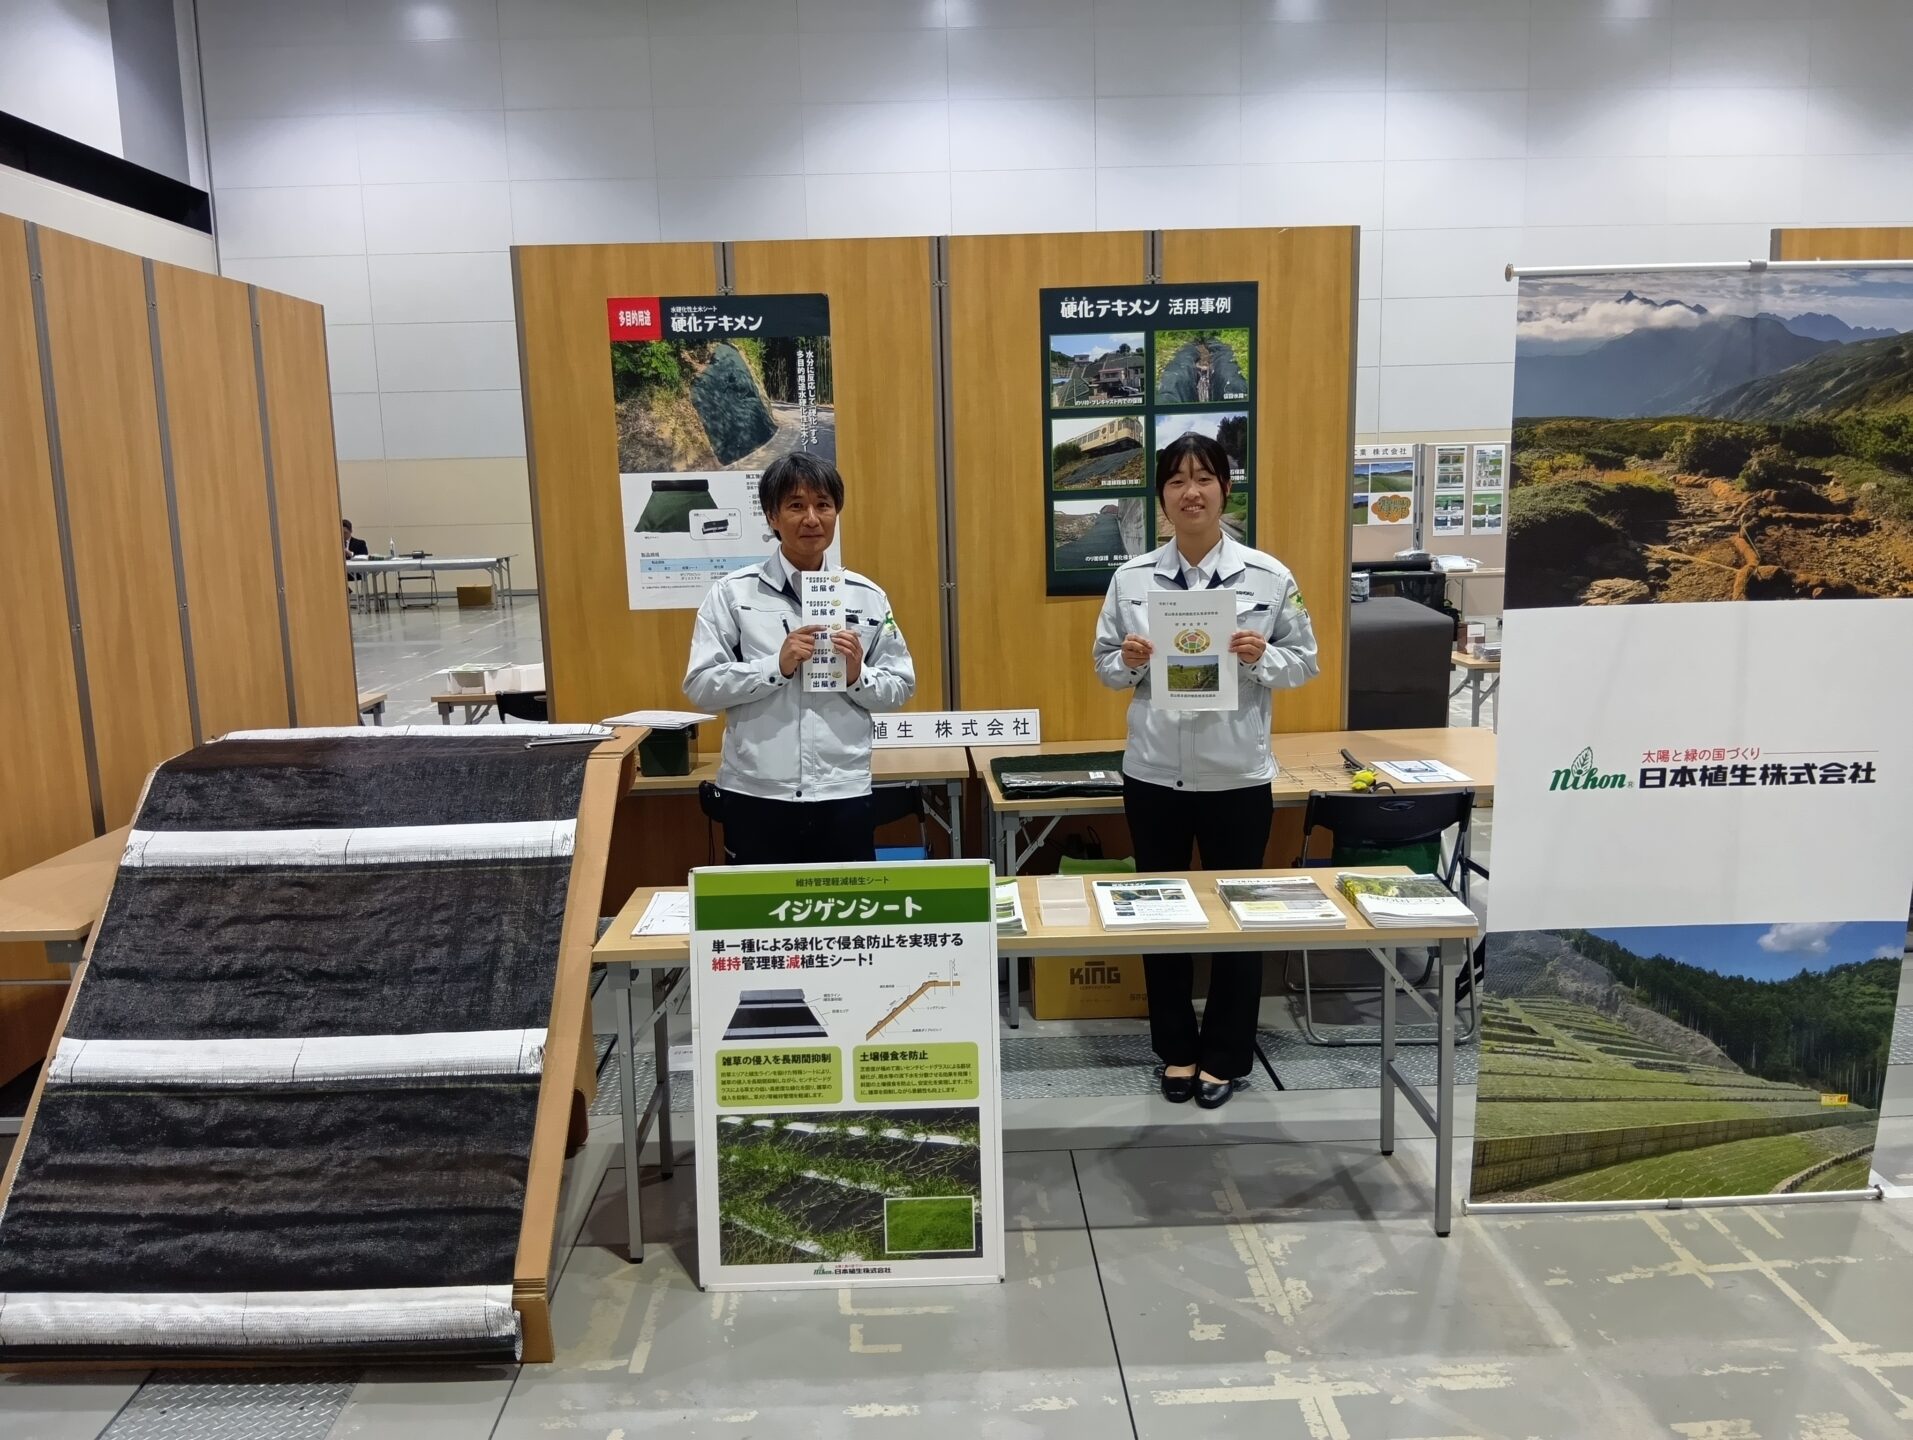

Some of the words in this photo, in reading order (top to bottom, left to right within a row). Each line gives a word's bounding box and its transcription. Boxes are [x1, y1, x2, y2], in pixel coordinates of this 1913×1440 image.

[1060, 299, 1160, 319] 硬化テキメン
[1168, 297, 1232, 316] 活用事例
[618, 310, 652, 327] 多目的用途
[671, 315, 763, 332] 硬化テキメン
[1373, 447, 1407, 456] 株式会社
[873, 720, 914, 740] 植生
[935, 717, 1031, 738] 株式会社
[1641, 747, 1761, 763] 太陽と緑の国づくり
[1638, 761, 1877, 789] 日本植生株式会社
[795, 875, 889, 888] 維持管理軽減植生シート
[768, 896, 922, 922] イジゲンシート
[711, 932, 964, 954] 単一種による緑化で侵食防止を実現する
[711, 953, 874, 971] 維持管理軽減植生シート!
[1069, 966, 1121, 985] KING
[722, 1053, 832, 1066] 雑草の侵入を長期間抑制
[859, 1050, 929, 1062] 土壌侵食を防止
